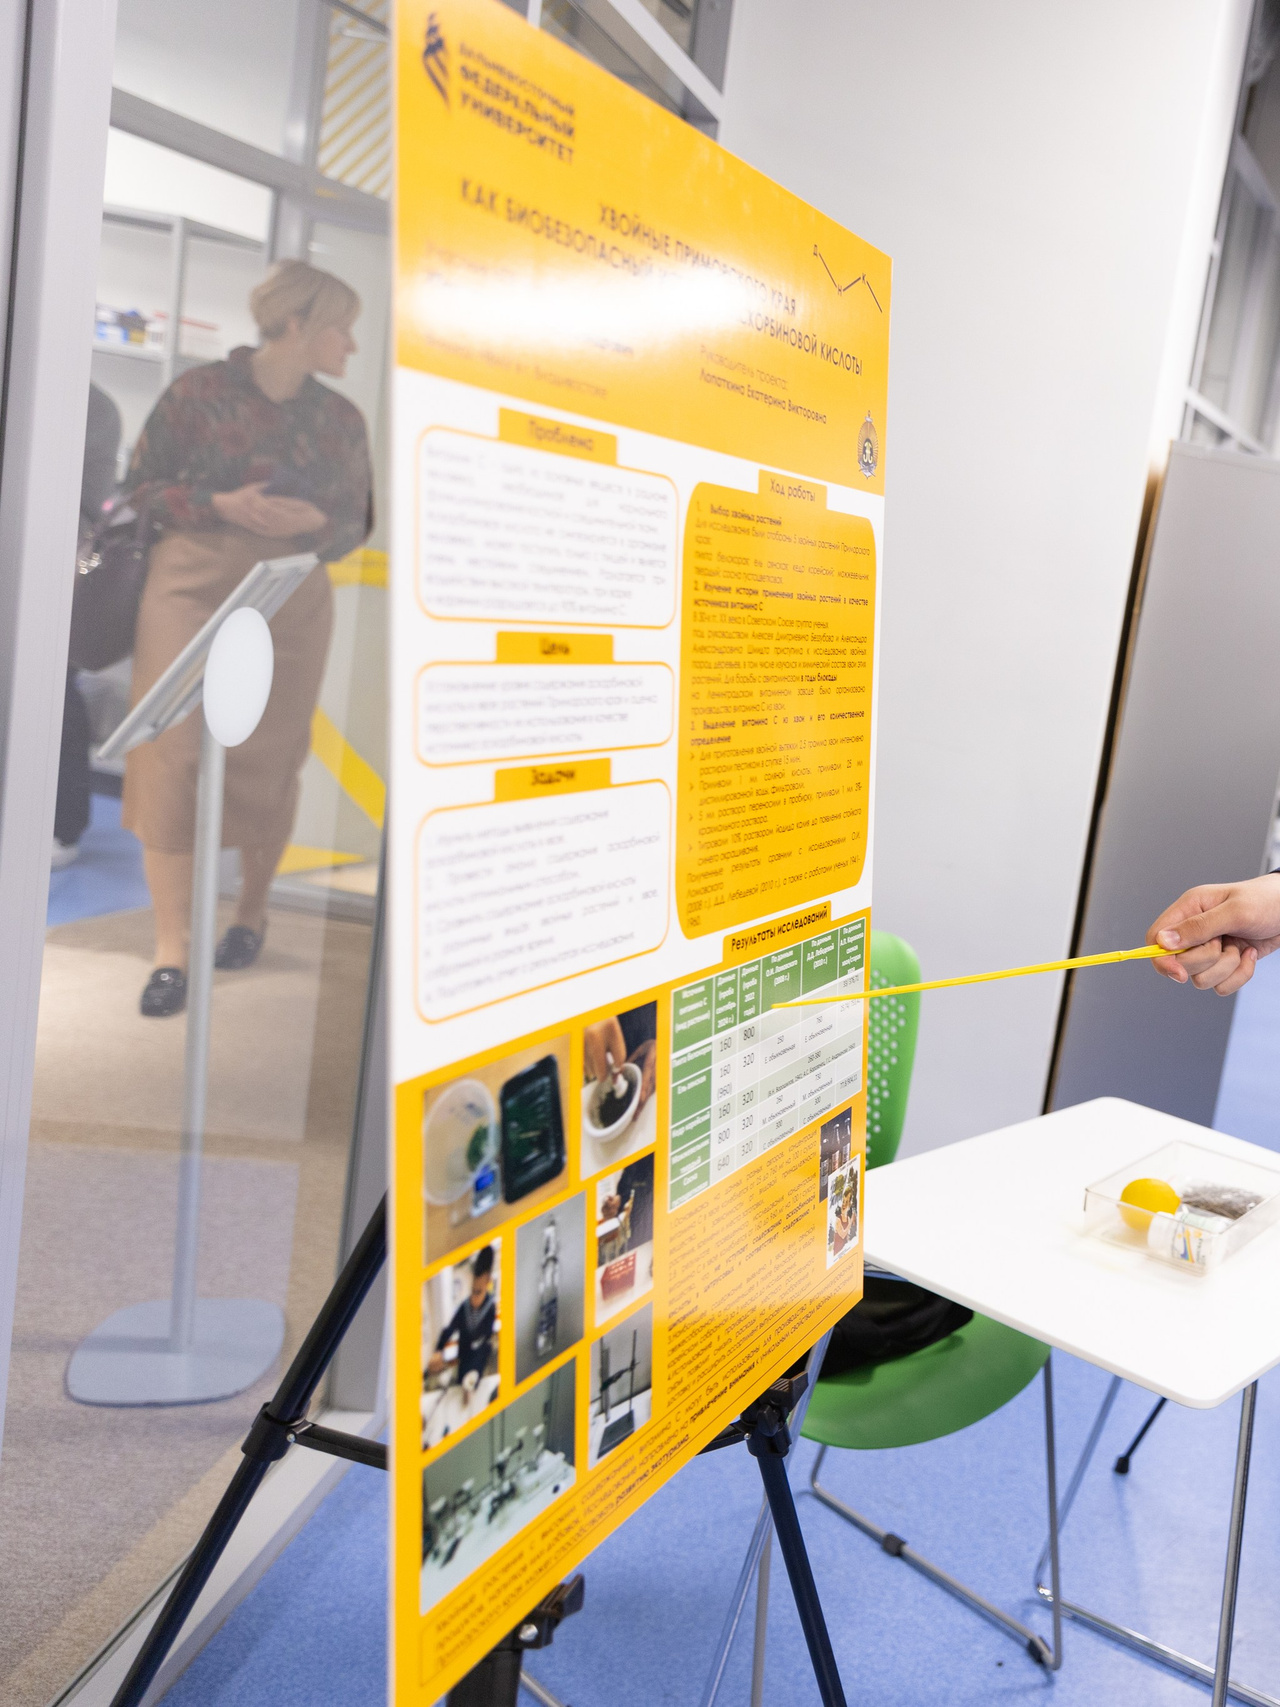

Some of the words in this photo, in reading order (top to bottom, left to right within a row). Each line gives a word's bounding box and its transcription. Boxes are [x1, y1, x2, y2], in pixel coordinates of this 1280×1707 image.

[460, 61, 574, 141] ФЕДЕРАЛЬНЫЙ
[459, 87, 574, 167] УНИВЕРСИТЕТ
[599, 195, 669, 257] ХВОЙНЫЕ
[675, 239, 767, 304] ПРИМОРСКОГО
[771, 287, 795, 318] КРАЯ
[461, 176, 496, 217] КАК
[506, 189, 653, 286] БИОБЕЗОПАСНЫЙ
[740, 300, 816, 357] СКОРБИНОВОЙ
[820, 340, 862, 377] КИСЛОТЫ
[700, 344, 754, 381] Руководитель
[699, 366, 744, 397] Лопаткина
[747, 384, 786, 411] Екатерина
[787, 398, 826, 425] Викторовна
[529, 419, 594, 453] Проблема
[770, 479, 785, 495] Ход
[787, 482, 815, 504] работы
[541, 638, 570, 656] Цель
[531, 764, 575, 786] Задачи
[731, 924, 775, 955] Результаты
[777, 905, 827, 936] исследований
[743, 1025, 755, 1042] 800
[719, 1035, 732, 1053] 160
[742, 1051, 754, 1068] 320
[719, 1062, 731, 1079] 160
[716, 1081, 732, 1102] (960)
[742, 1089, 753, 1107] 320
[718, 1102, 730, 1120] 160
[741, 1113, 753, 1131] 320
[717, 1126, 730, 1145] 800
[741, 1139, 753, 1157] 320
[717, 1153, 729, 1172] 640
